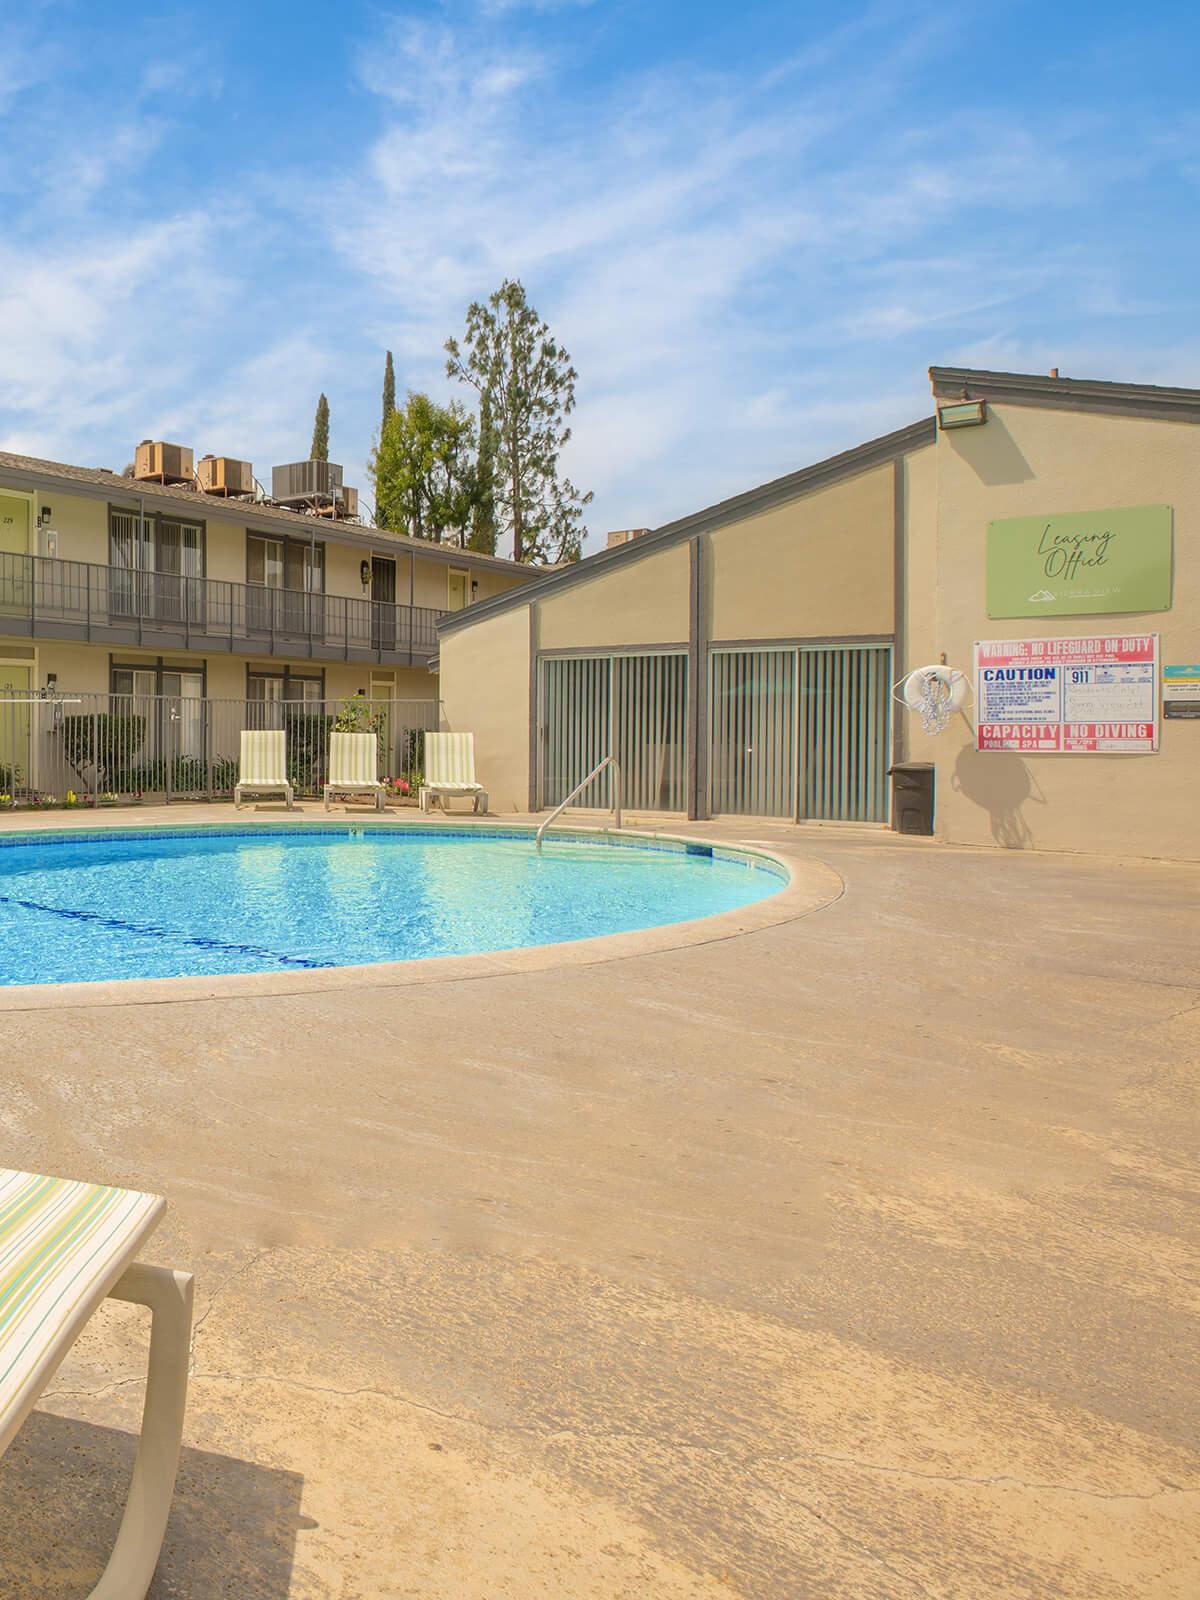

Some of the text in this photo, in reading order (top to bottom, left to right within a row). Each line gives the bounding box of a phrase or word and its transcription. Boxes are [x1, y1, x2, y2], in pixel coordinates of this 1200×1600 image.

[1038, 523, 1116, 556] Leasing
[1044, 547, 1109, 580] Office
[982, 642, 1029, 658] WARNING:
[1031, 640, 1044, 655] NO
[1047, 638, 1101, 655] LIFEGUARD
[1105, 638, 1120, 652] ON
[1121, 636, 1150, 652] DUTY
[984, 668, 1056, 682] CAUTION
[1071, 670, 1089, 684] 911
[982, 725, 1058, 739] CAPACITY
[1070, 724, 1147, 739] NO DIVING
[1021, 740, 1038, 749] SPA
